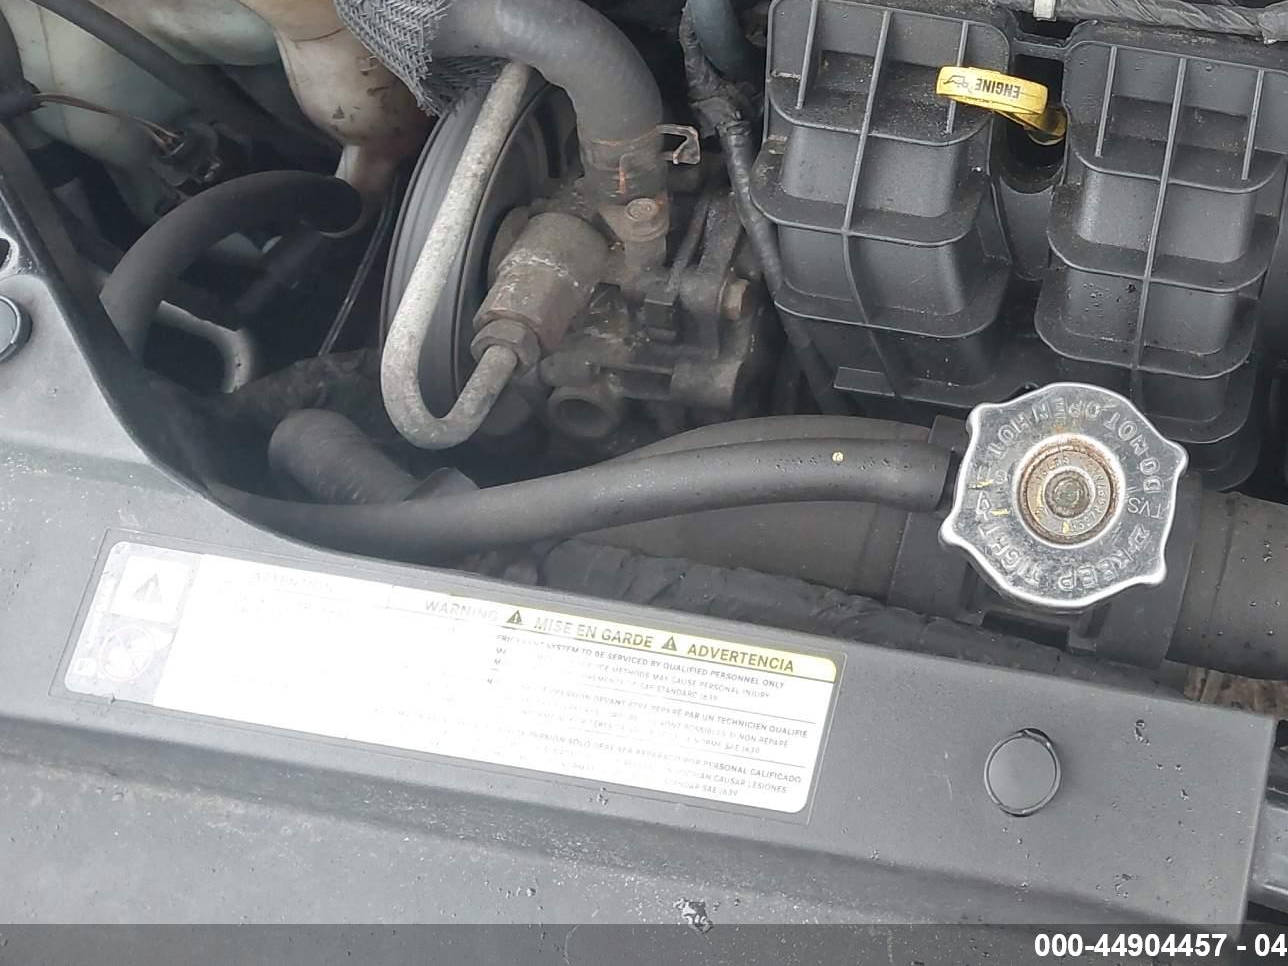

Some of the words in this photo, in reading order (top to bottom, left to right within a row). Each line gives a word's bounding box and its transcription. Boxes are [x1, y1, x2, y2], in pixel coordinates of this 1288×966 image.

[975, 78, 1021, 99] ENGINE
[1032, 397, 1102, 421] OPEN
[988, 414, 1033, 459] HOT
[1104, 411, 1149, 454] NOT
[1140, 457, 1162, 492] DO
[534, 616, 572, 634] MISE
[576, 623, 597, 638] EN
[600, 627, 653, 648] GARDE
[686, 642, 794, 672] ADVERTENCIA
[607, 652, 648, 665] SERVICED
[650, 659, 660, 668] BY
[662, 661, 708, 676] QUALIFIED
[710, 670, 759, 685] PERSONNEL
[761, 678, 784, 689] ONLY
[716, 715, 767, 731] TECHNICIEN
[749, 768, 802, 784] CALIFICADO
